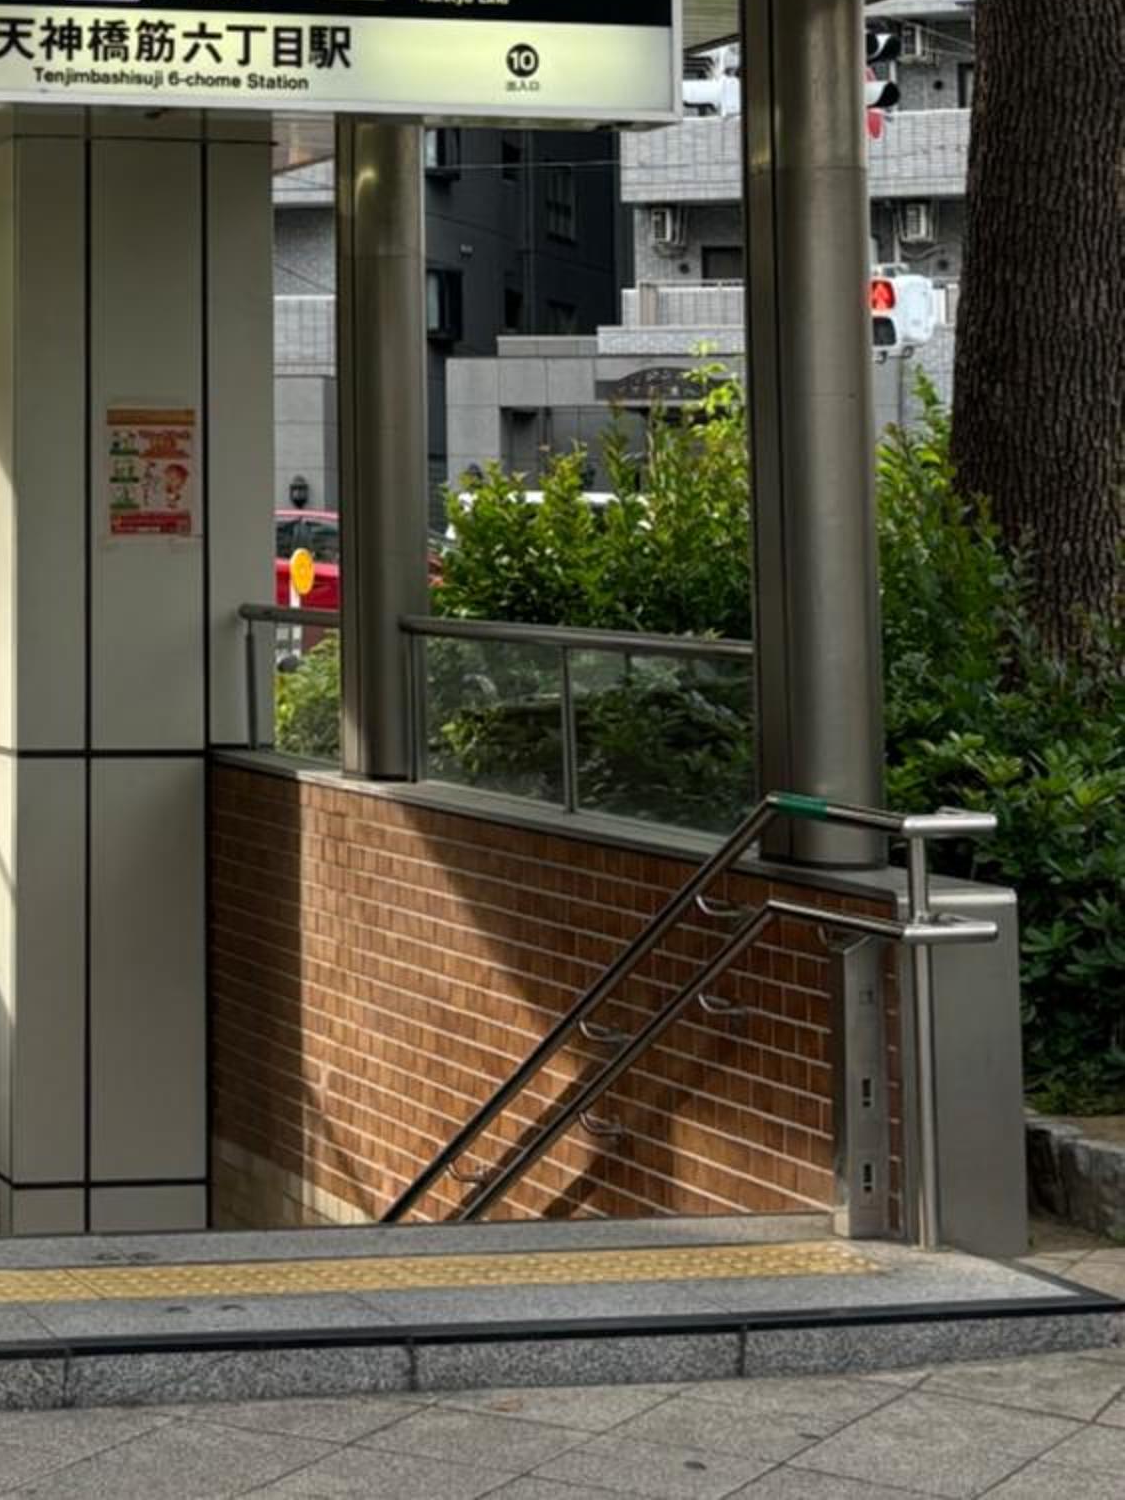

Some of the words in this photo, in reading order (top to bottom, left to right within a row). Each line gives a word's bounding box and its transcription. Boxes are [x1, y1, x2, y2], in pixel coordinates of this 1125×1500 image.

[510, 50, 536, 71] 10
[33, 67, 164, 89] Tenjimbashisuji
[167, 70, 242, 88] 6-chome
[246, 73, 309, 90] Station
